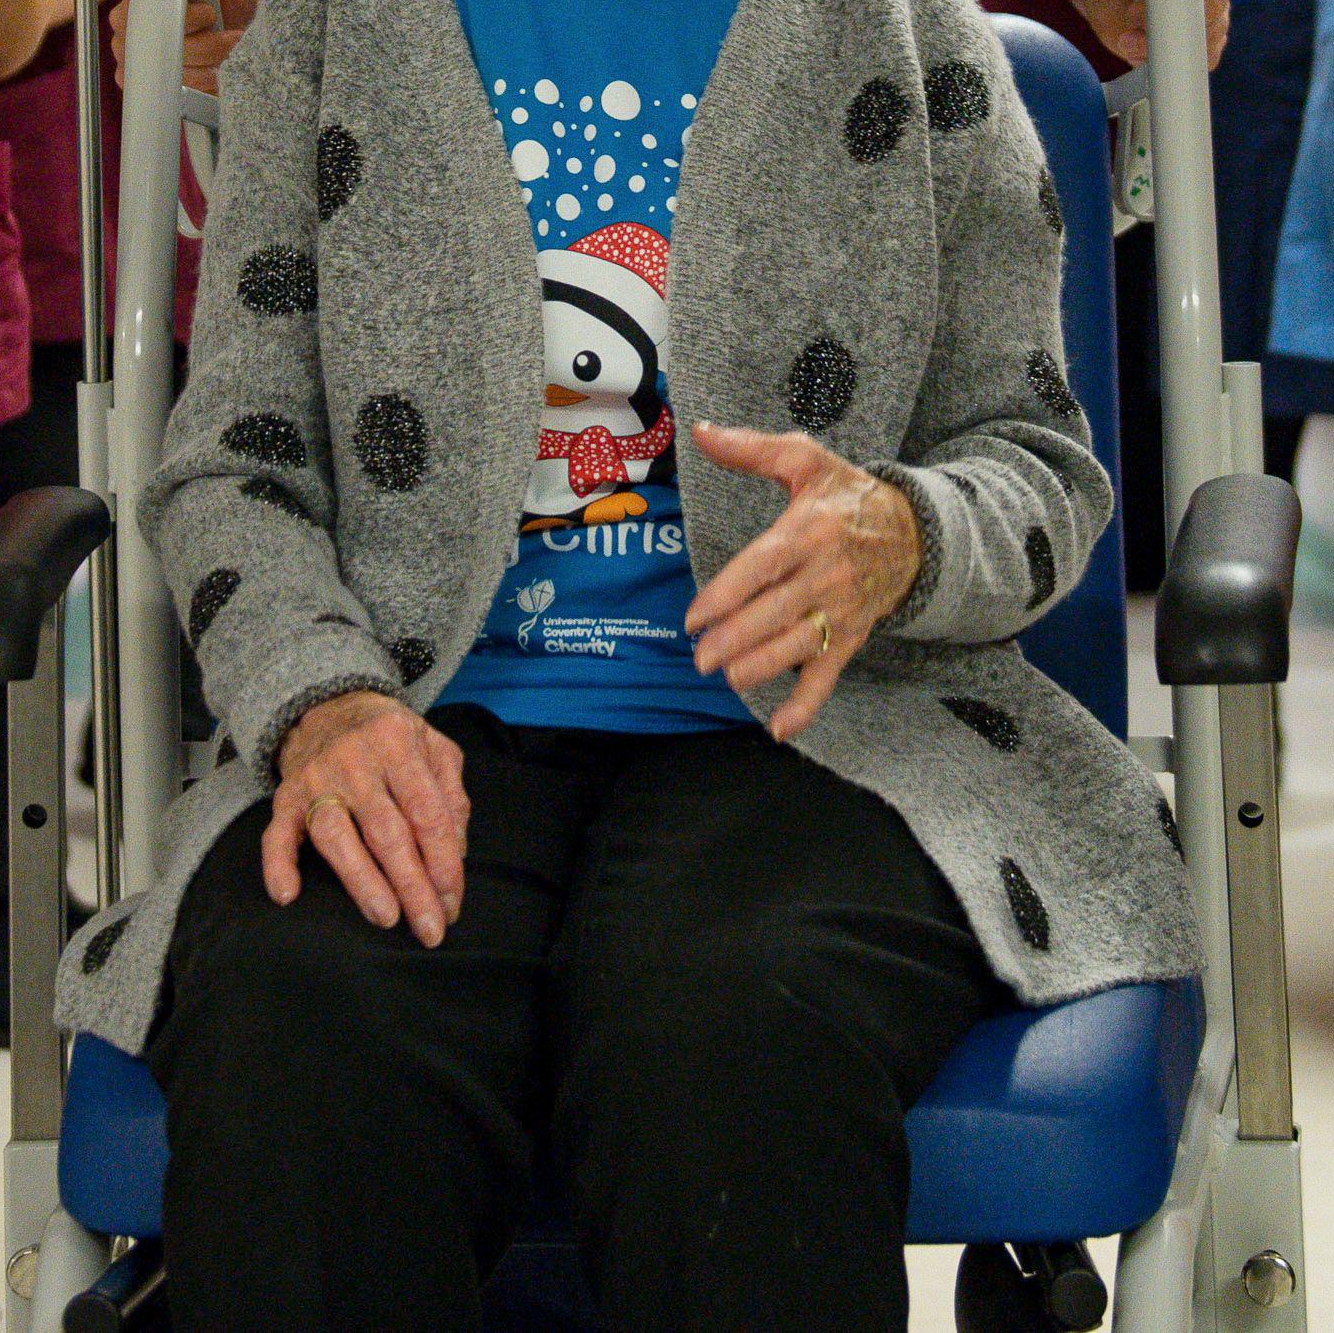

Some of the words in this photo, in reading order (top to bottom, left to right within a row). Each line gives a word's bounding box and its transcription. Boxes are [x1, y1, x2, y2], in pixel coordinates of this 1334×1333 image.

[542, 522, 683, 557] Chris
[543, 617, 597, 626] University
[543, 626, 593, 638] Coventry
[594, 626, 603, 637] &
[604, 625, 678, 640] Warwickshire
[544, 637, 617, 657] Charity
